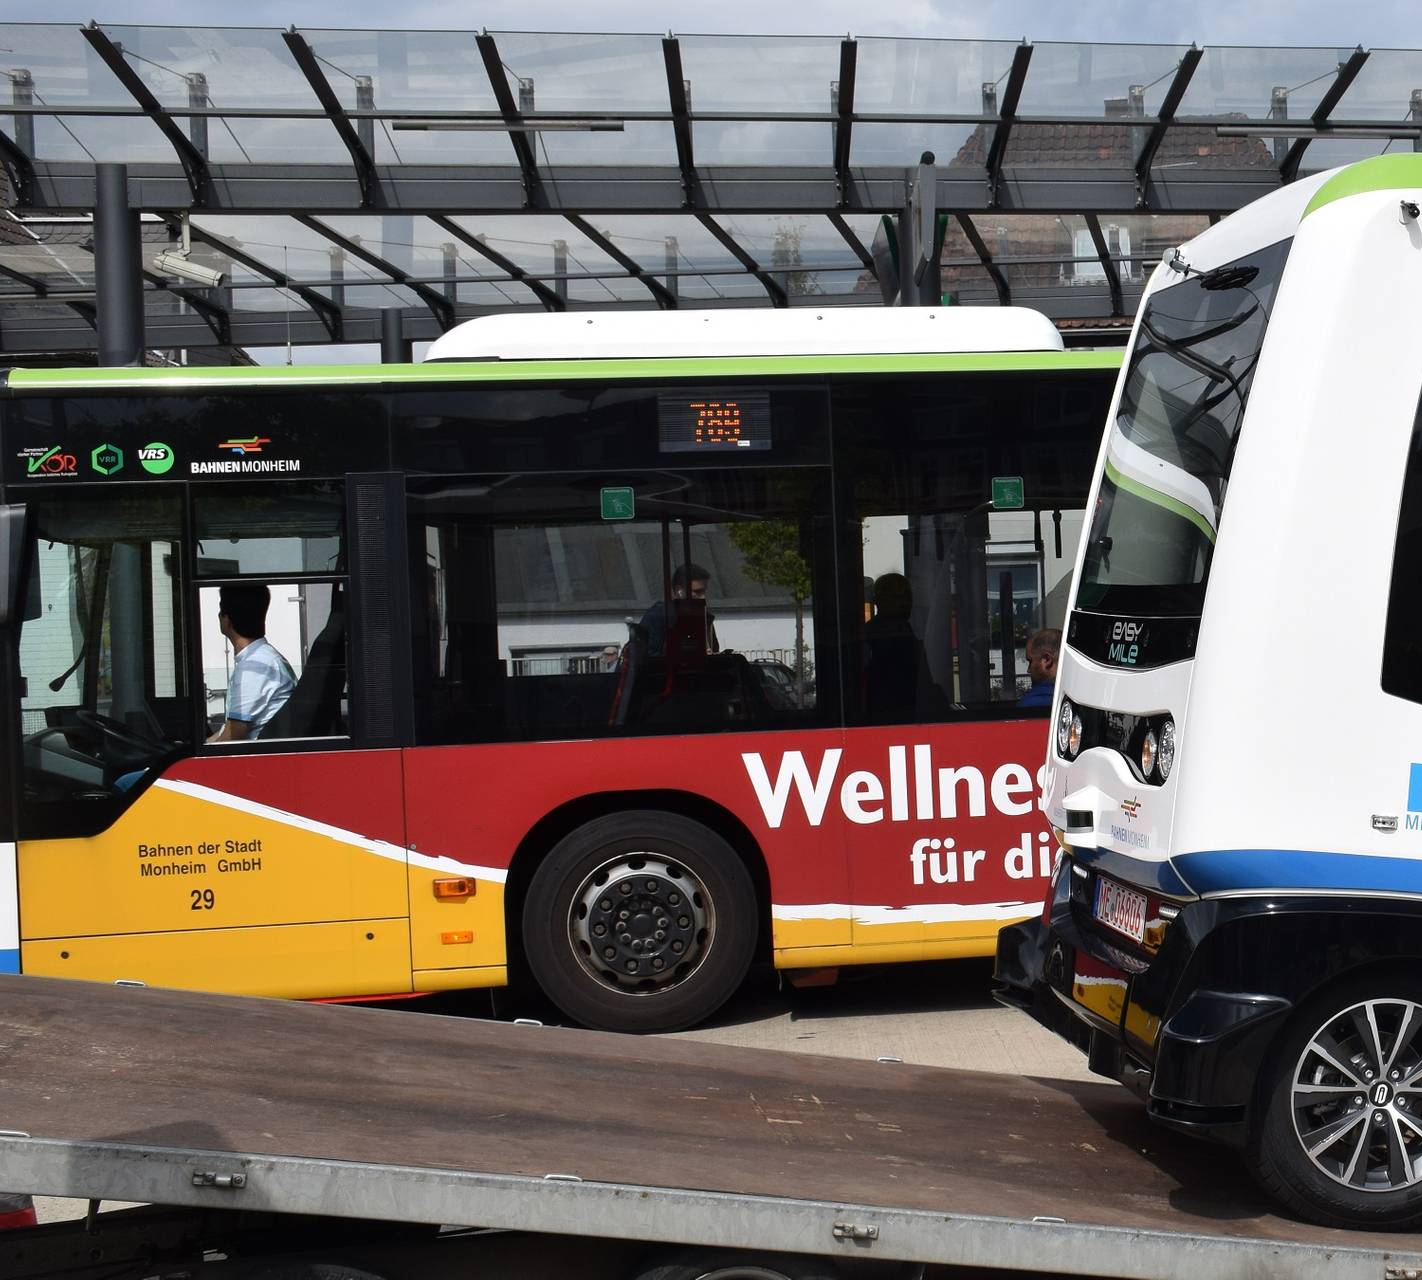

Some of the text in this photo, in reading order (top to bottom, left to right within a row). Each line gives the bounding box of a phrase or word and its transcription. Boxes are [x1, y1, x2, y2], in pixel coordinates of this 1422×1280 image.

[137, 448, 166, 460] VRS
[742, 744, 1048, 828] Wellne
[138, 839, 262, 858] Bahnen der Stadt
[140, 858, 262, 876] Monheim GmbH
[910, 832, 1063, 887] für di
[190, 888, 215, 910] 29
